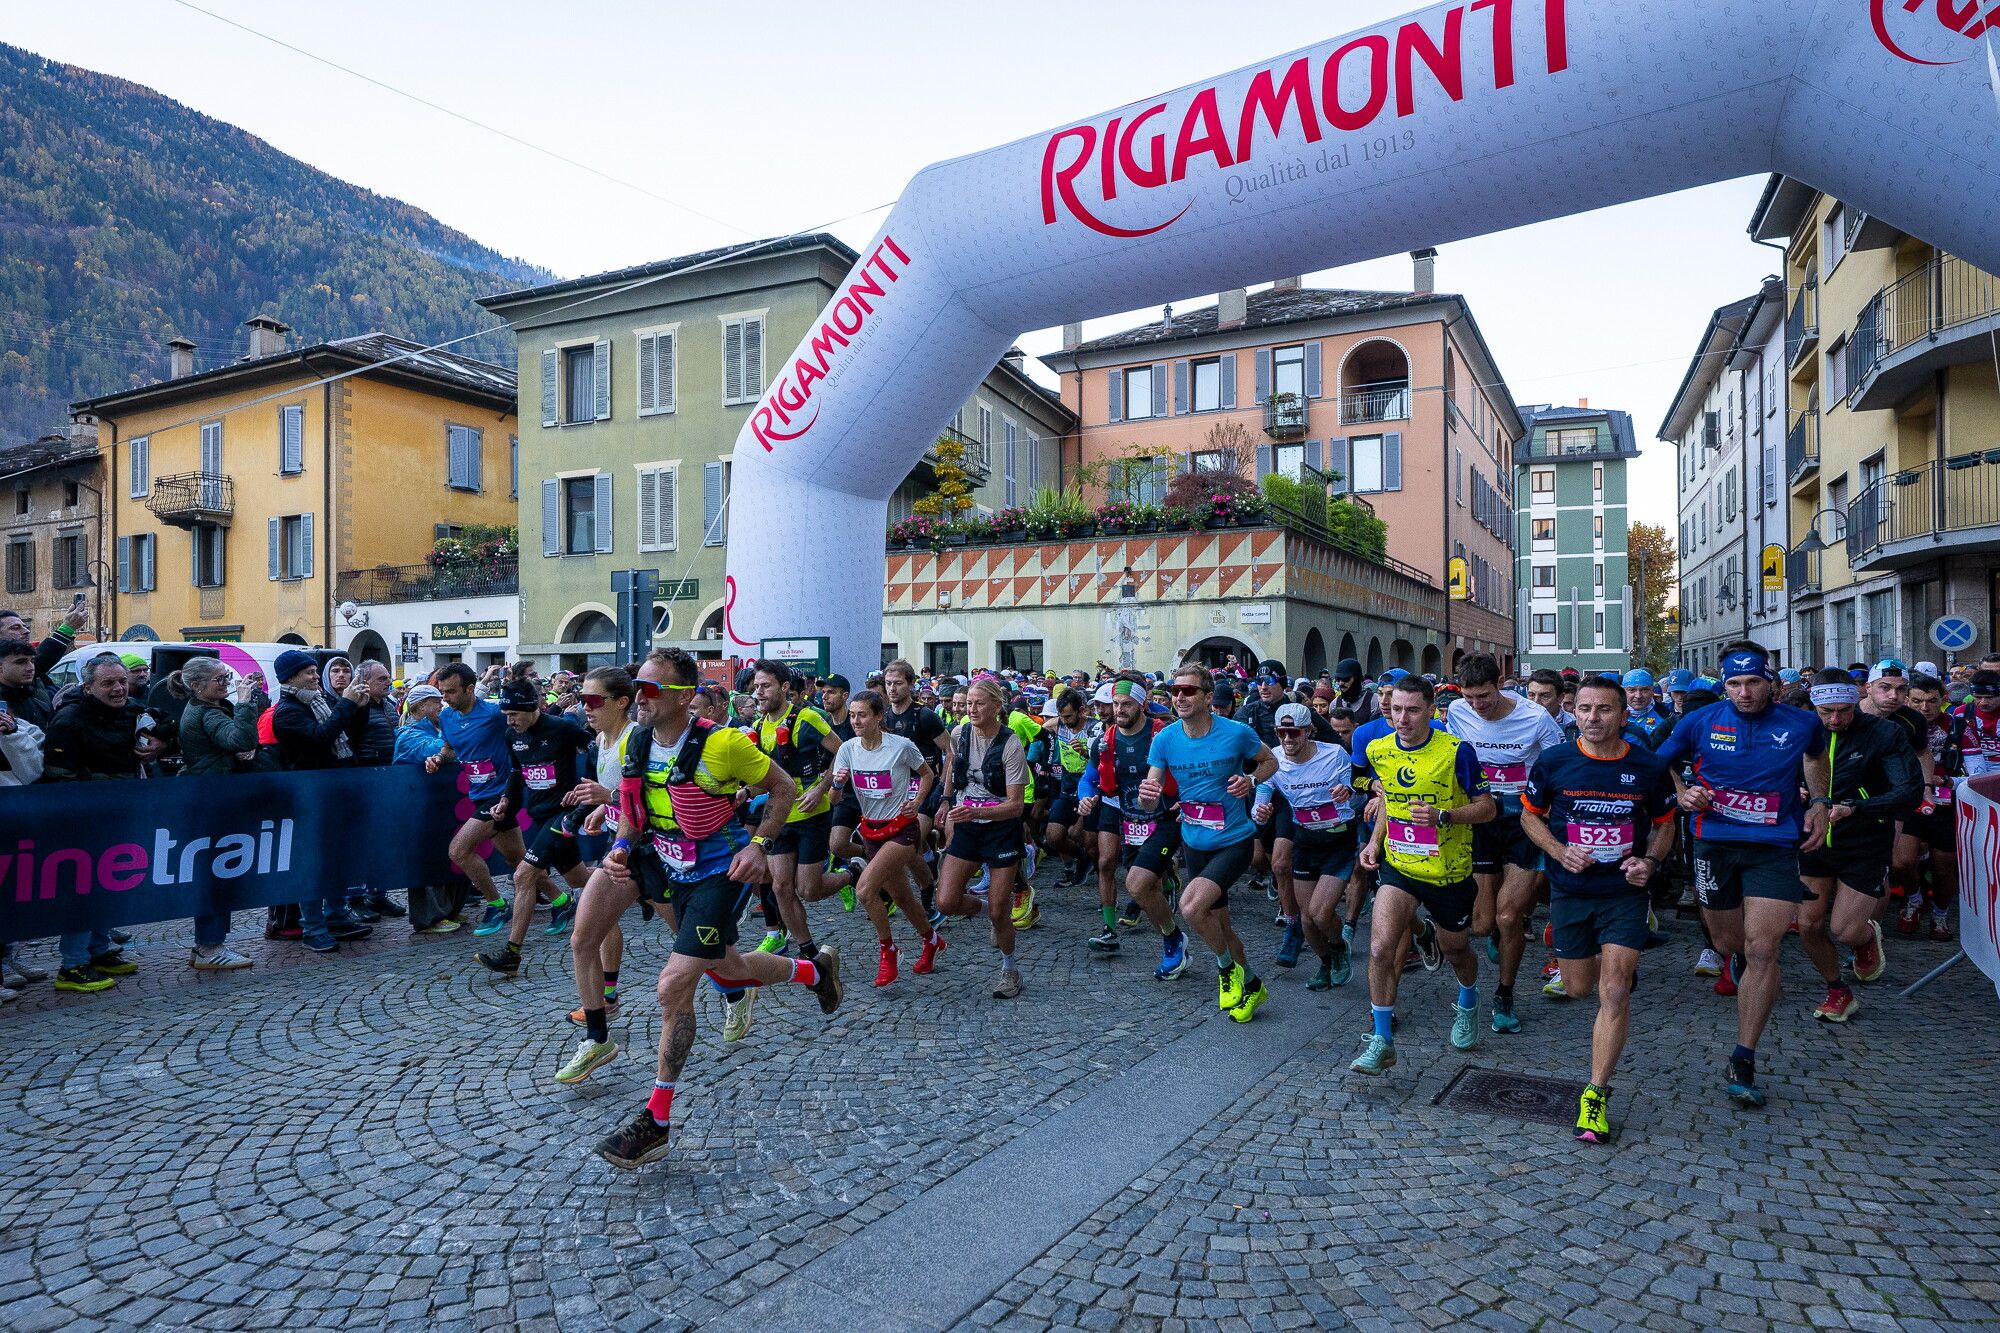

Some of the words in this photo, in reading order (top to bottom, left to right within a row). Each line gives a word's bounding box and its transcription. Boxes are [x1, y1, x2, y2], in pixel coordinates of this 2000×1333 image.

[1041, 0, 1568, 238] RIGAMONTI
[1224, 157, 1309, 206] Qualità
[1314, 148, 1351, 176] dal
[1362, 130, 1417, 163] 1913
[865, 315, 883, 338] 1913
[751, 235, 911, 453] RIGAMONTI
[403, 633, 416, 650] T
[1476, 741, 1523, 750] SCARPA
[1710, 743, 1736, 751] VAM
[471, 764, 480, 775] 3
[527, 768, 548, 780] 959
[1494, 769, 1506, 781] 4
[864, 776, 878, 789] 16
[1620, 773, 1636, 783] SLP
[1290, 781, 1329, 790] SCARPA
[1572, 799, 1633, 814] Triathlon
[1726, 792, 1768, 812] 748
[1195, 805, 1205, 818] 7
[1310, 811, 1321, 822] 8
[1128, 823, 1149, 836] 989
[1403, 826, 1416, 842] 6
[1579, 827, 1622, 845] 523
